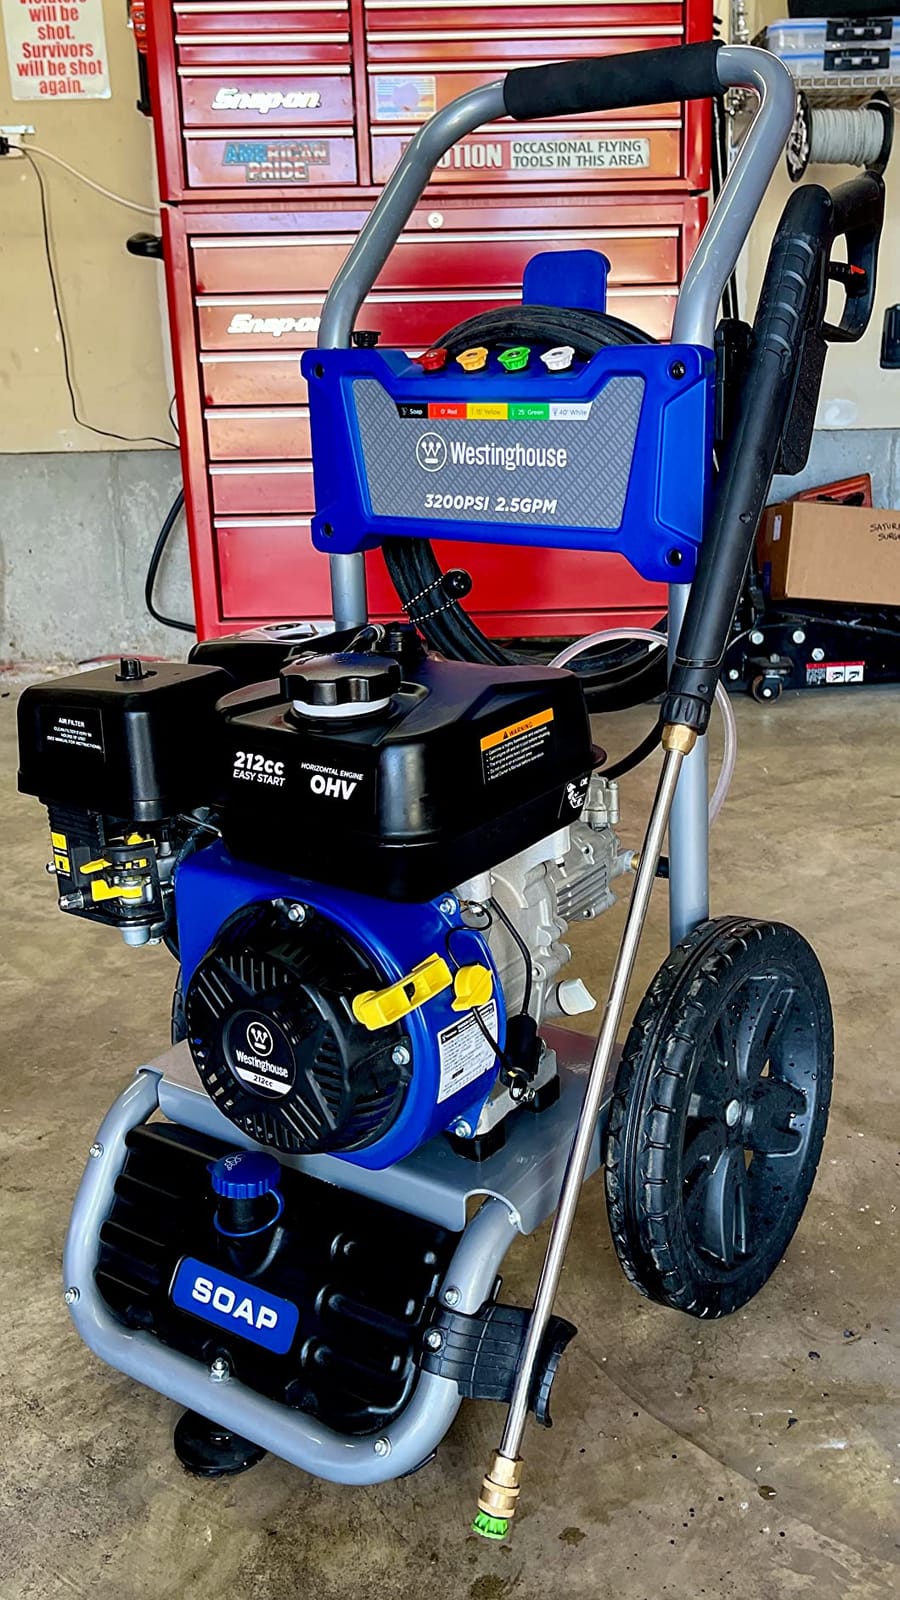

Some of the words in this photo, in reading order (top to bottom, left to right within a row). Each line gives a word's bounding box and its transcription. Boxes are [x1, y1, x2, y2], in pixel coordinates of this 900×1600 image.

[29, 5, 57, 22] will
[60, 5, 79, 21] be
[37, 24, 75, 40] shot.
[22, 42, 94, 59] Survivors
[16, 60, 44, 77] will
[47, 60, 66, 76] be
[69, 58, 103, 76] shot
[39, 77, 85, 96] again.
[223, 143, 329, 163] AMERICAN
[437, 143, 503, 169] UTION
[513, 141, 593, 153] OCCASIONAL
[598, 140, 642, 153] FLYING
[513, 156, 554, 167] TOOLS
[557, 155, 571, 167] IN
[575, 155, 605, 167] THIS
[608, 154, 645, 166] AREA
[248, 162, 307, 179] PRIDE
[450, 441, 567, 471] Westinghouse
[424, 493, 490, 511] 3200PSI
[495, 497, 557, 514] 2.5GPM
[233, 751, 285, 776] 212cc
[300, 762, 339, 776] HORIZONTAL
[339, 770, 364, 781] ENGINE
[232, 769, 257, 781] EASY
[256, 773, 286, 787] START
[310, 774, 357, 801] OHV
[235, 1049, 289, 1078] Westinghouse
[252, 1074, 273, 1088] 212cc
[191, 1276, 279, 1330] SOAP
